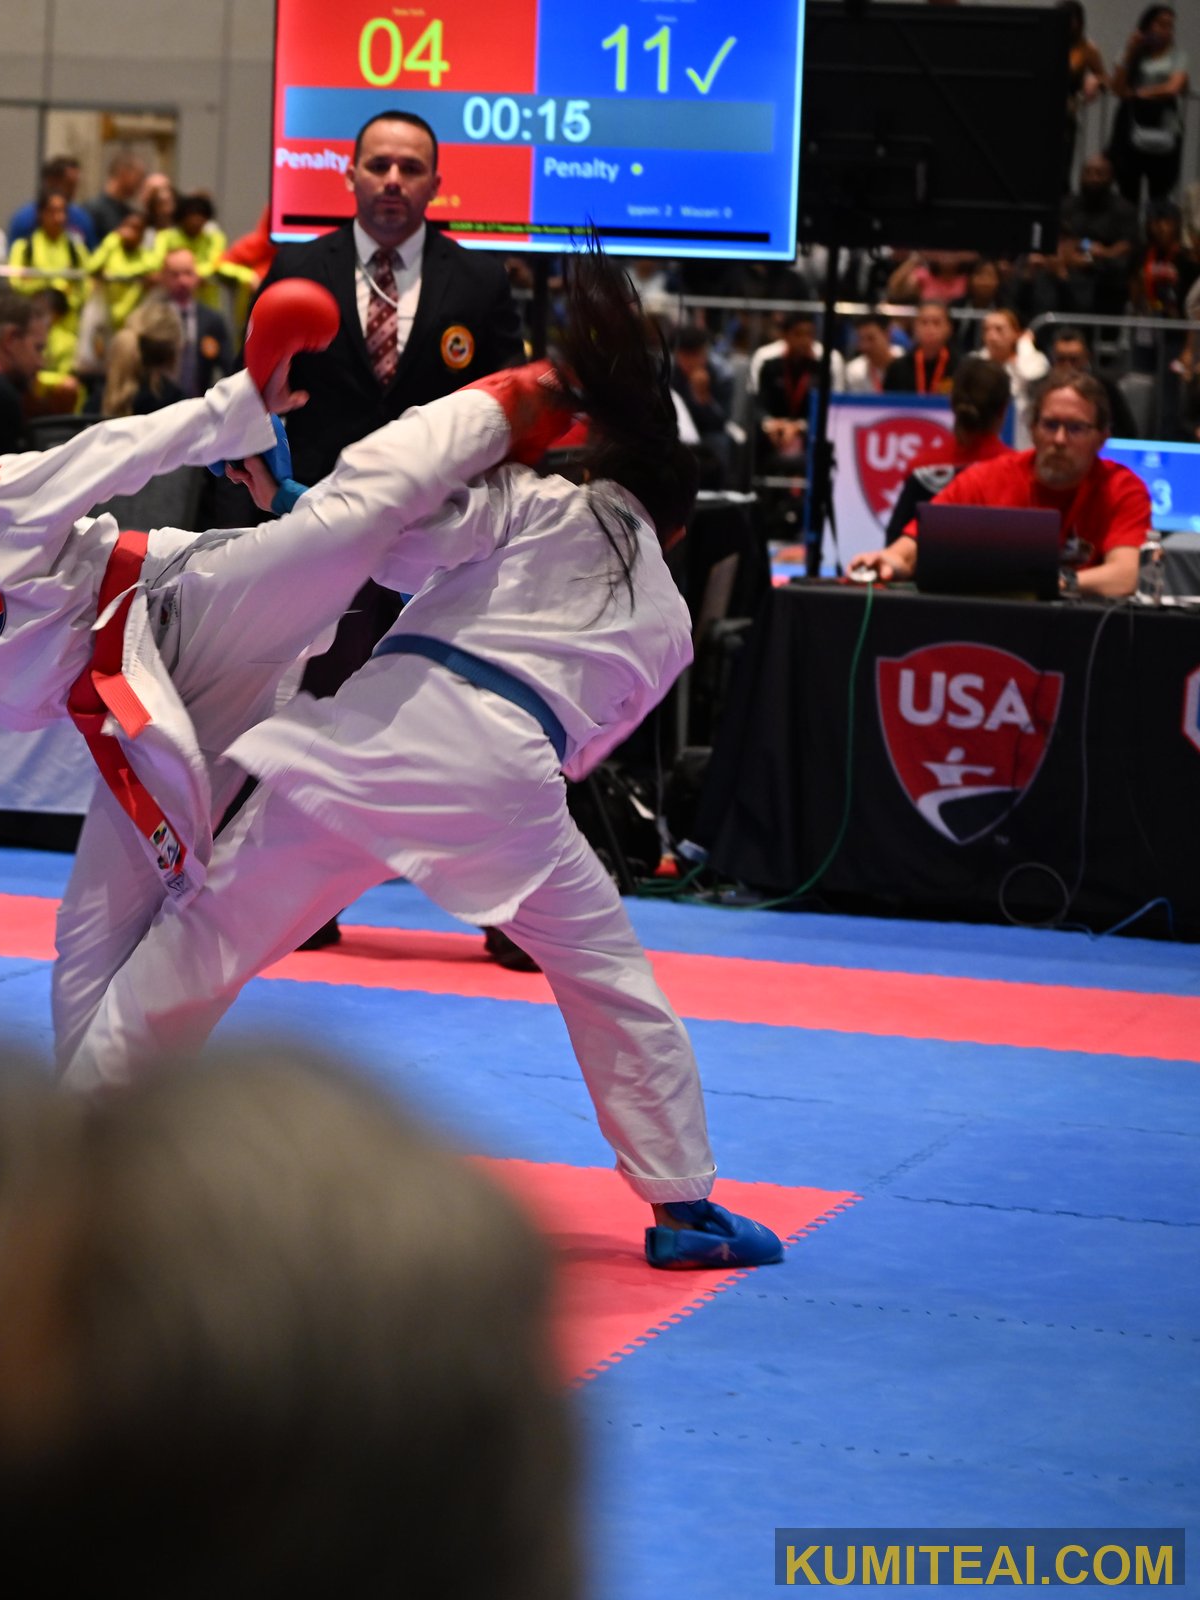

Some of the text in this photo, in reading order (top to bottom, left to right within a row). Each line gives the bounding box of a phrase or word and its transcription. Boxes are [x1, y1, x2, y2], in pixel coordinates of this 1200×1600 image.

[358, 17, 449, 87] 04
[602, 24, 670, 93] 11
[462, 96, 591, 142] 00:15
[275, 147, 350, 174] Penalty
[544, 156, 619, 183] Penalty
[866, 431, 943, 471] US
[899, 668, 1036, 734] USA
